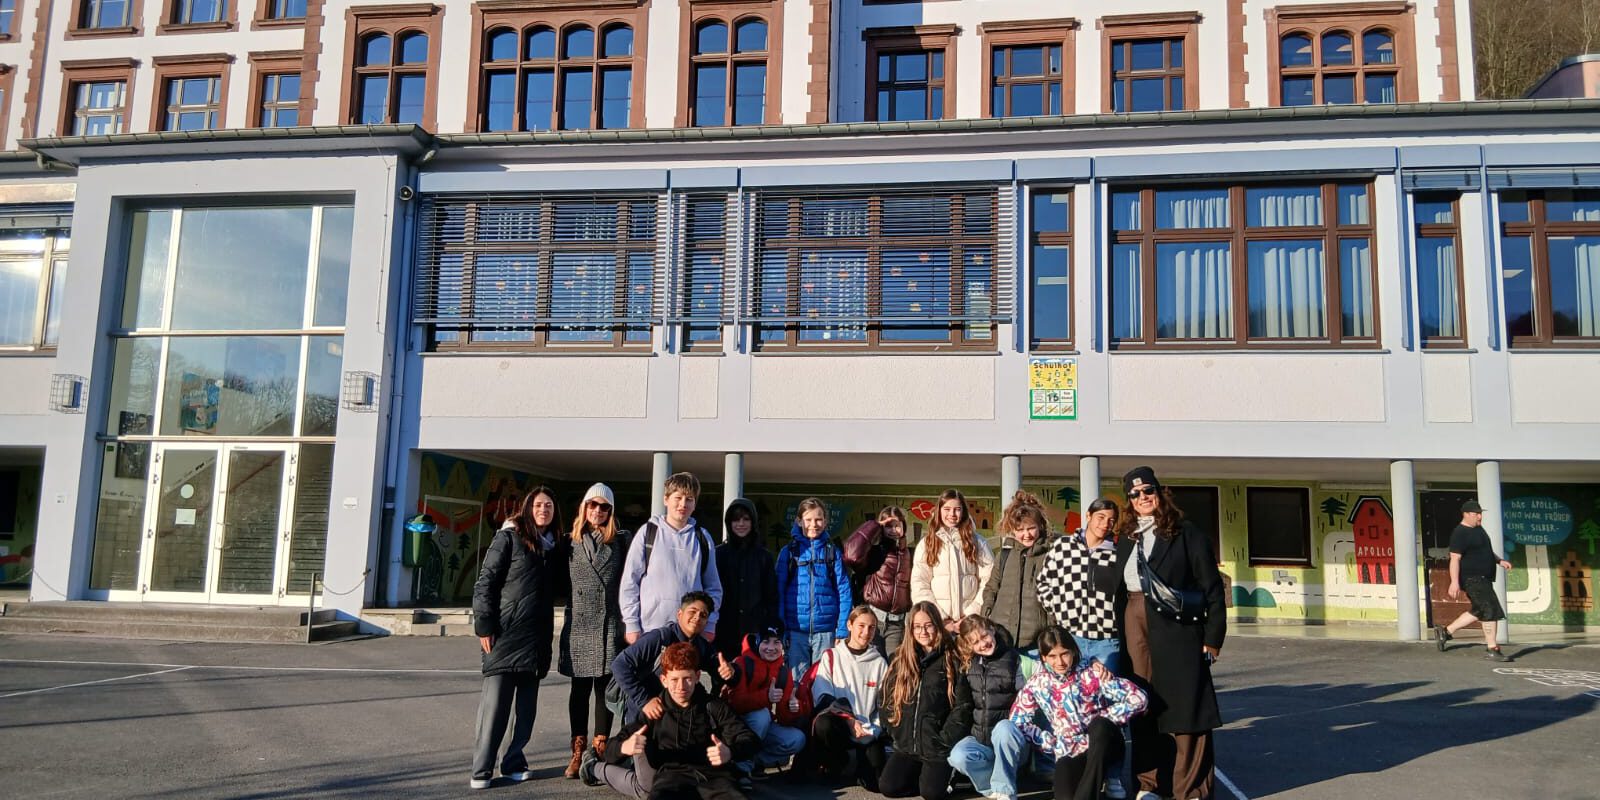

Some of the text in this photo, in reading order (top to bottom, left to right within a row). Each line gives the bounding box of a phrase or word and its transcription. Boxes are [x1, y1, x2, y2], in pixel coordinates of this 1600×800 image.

[1511, 500, 1525, 509] DAS
[1504, 511, 1522, 519] KINO
[1524, 511, 1541, 520] WAR
[1507, 522, 1524, 531] EINE
[1357, 546, 1393, 557] APOLLO
